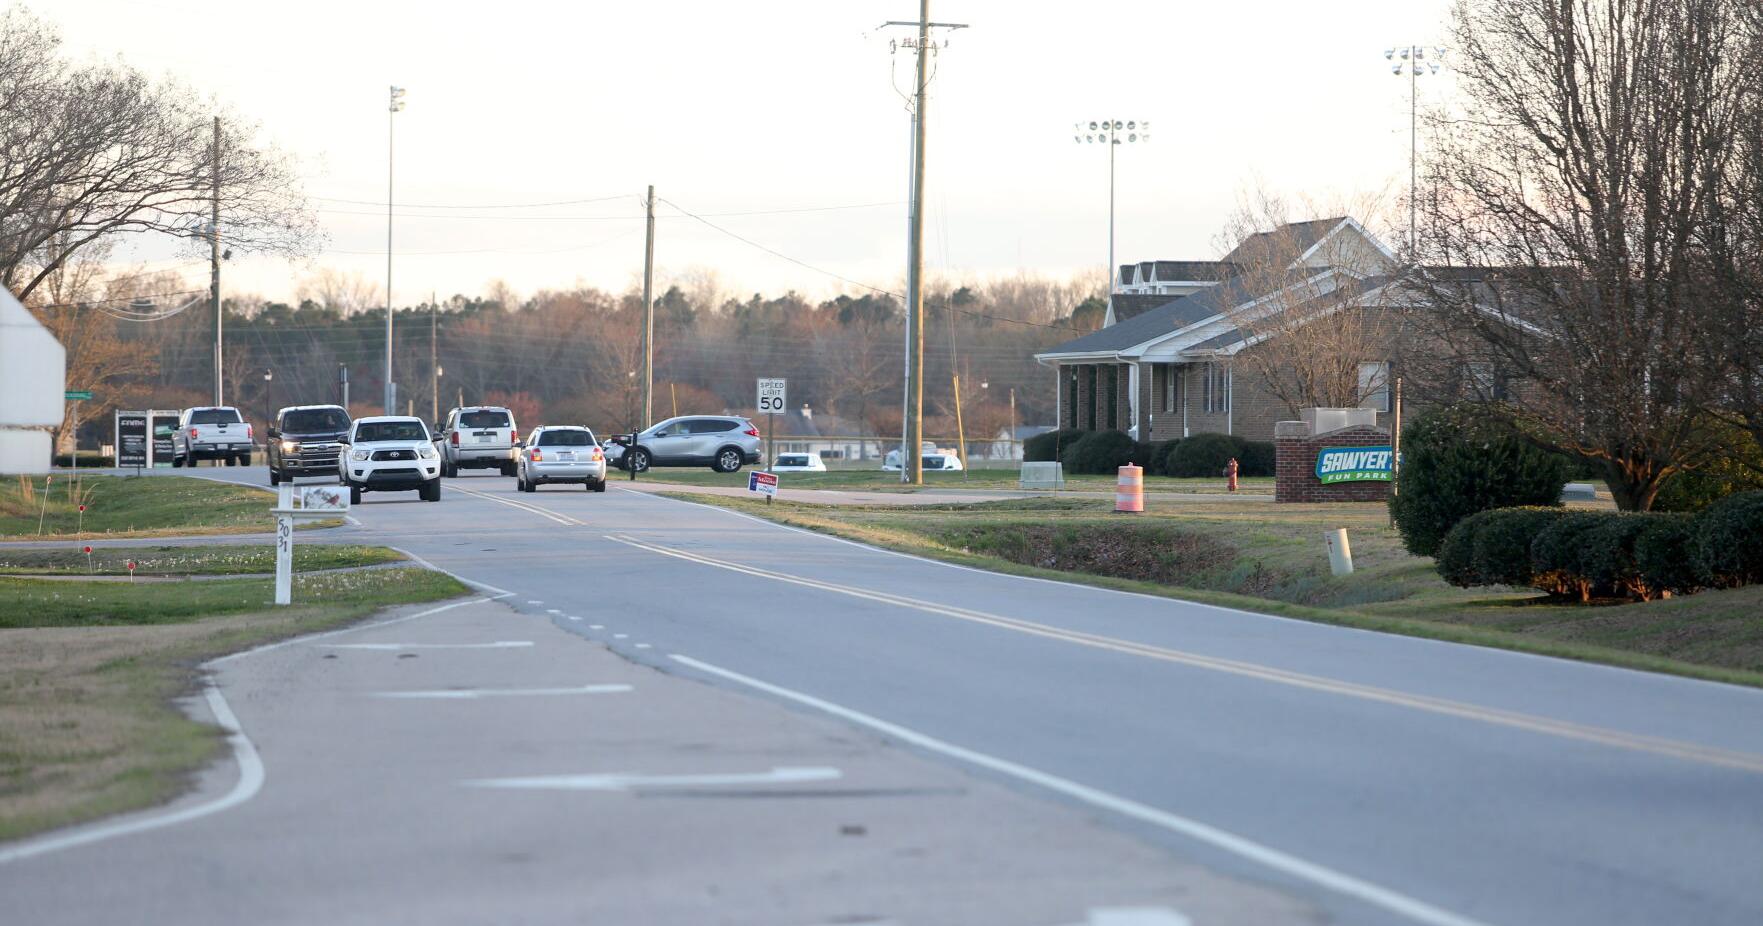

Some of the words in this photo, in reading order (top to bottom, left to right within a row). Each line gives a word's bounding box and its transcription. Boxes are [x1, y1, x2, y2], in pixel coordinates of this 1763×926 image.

[760, 396, 783, 410] 50
[1327, 473, 1351, 482] FUN
[1355, 472, 1388, 480] PARK
